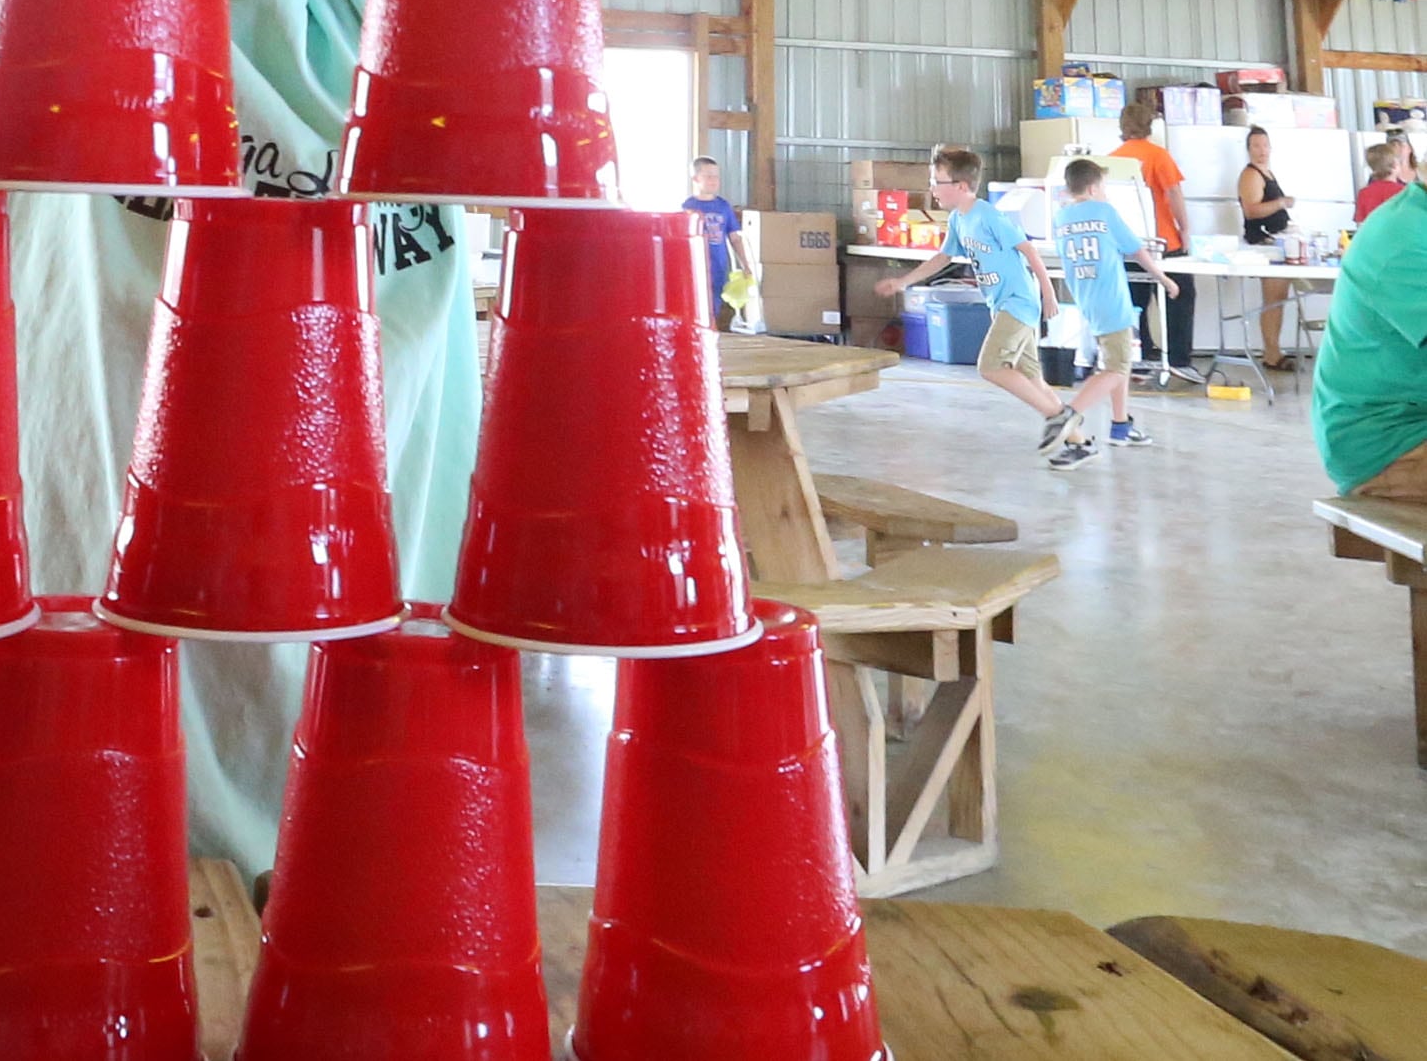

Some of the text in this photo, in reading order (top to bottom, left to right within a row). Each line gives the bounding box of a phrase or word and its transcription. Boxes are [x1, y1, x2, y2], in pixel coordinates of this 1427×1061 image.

[1071, 220, 1109, 234] MAKE
[799, 230, 832, 249] EGGS
[1065, 236, 1101, 263] 4-H
